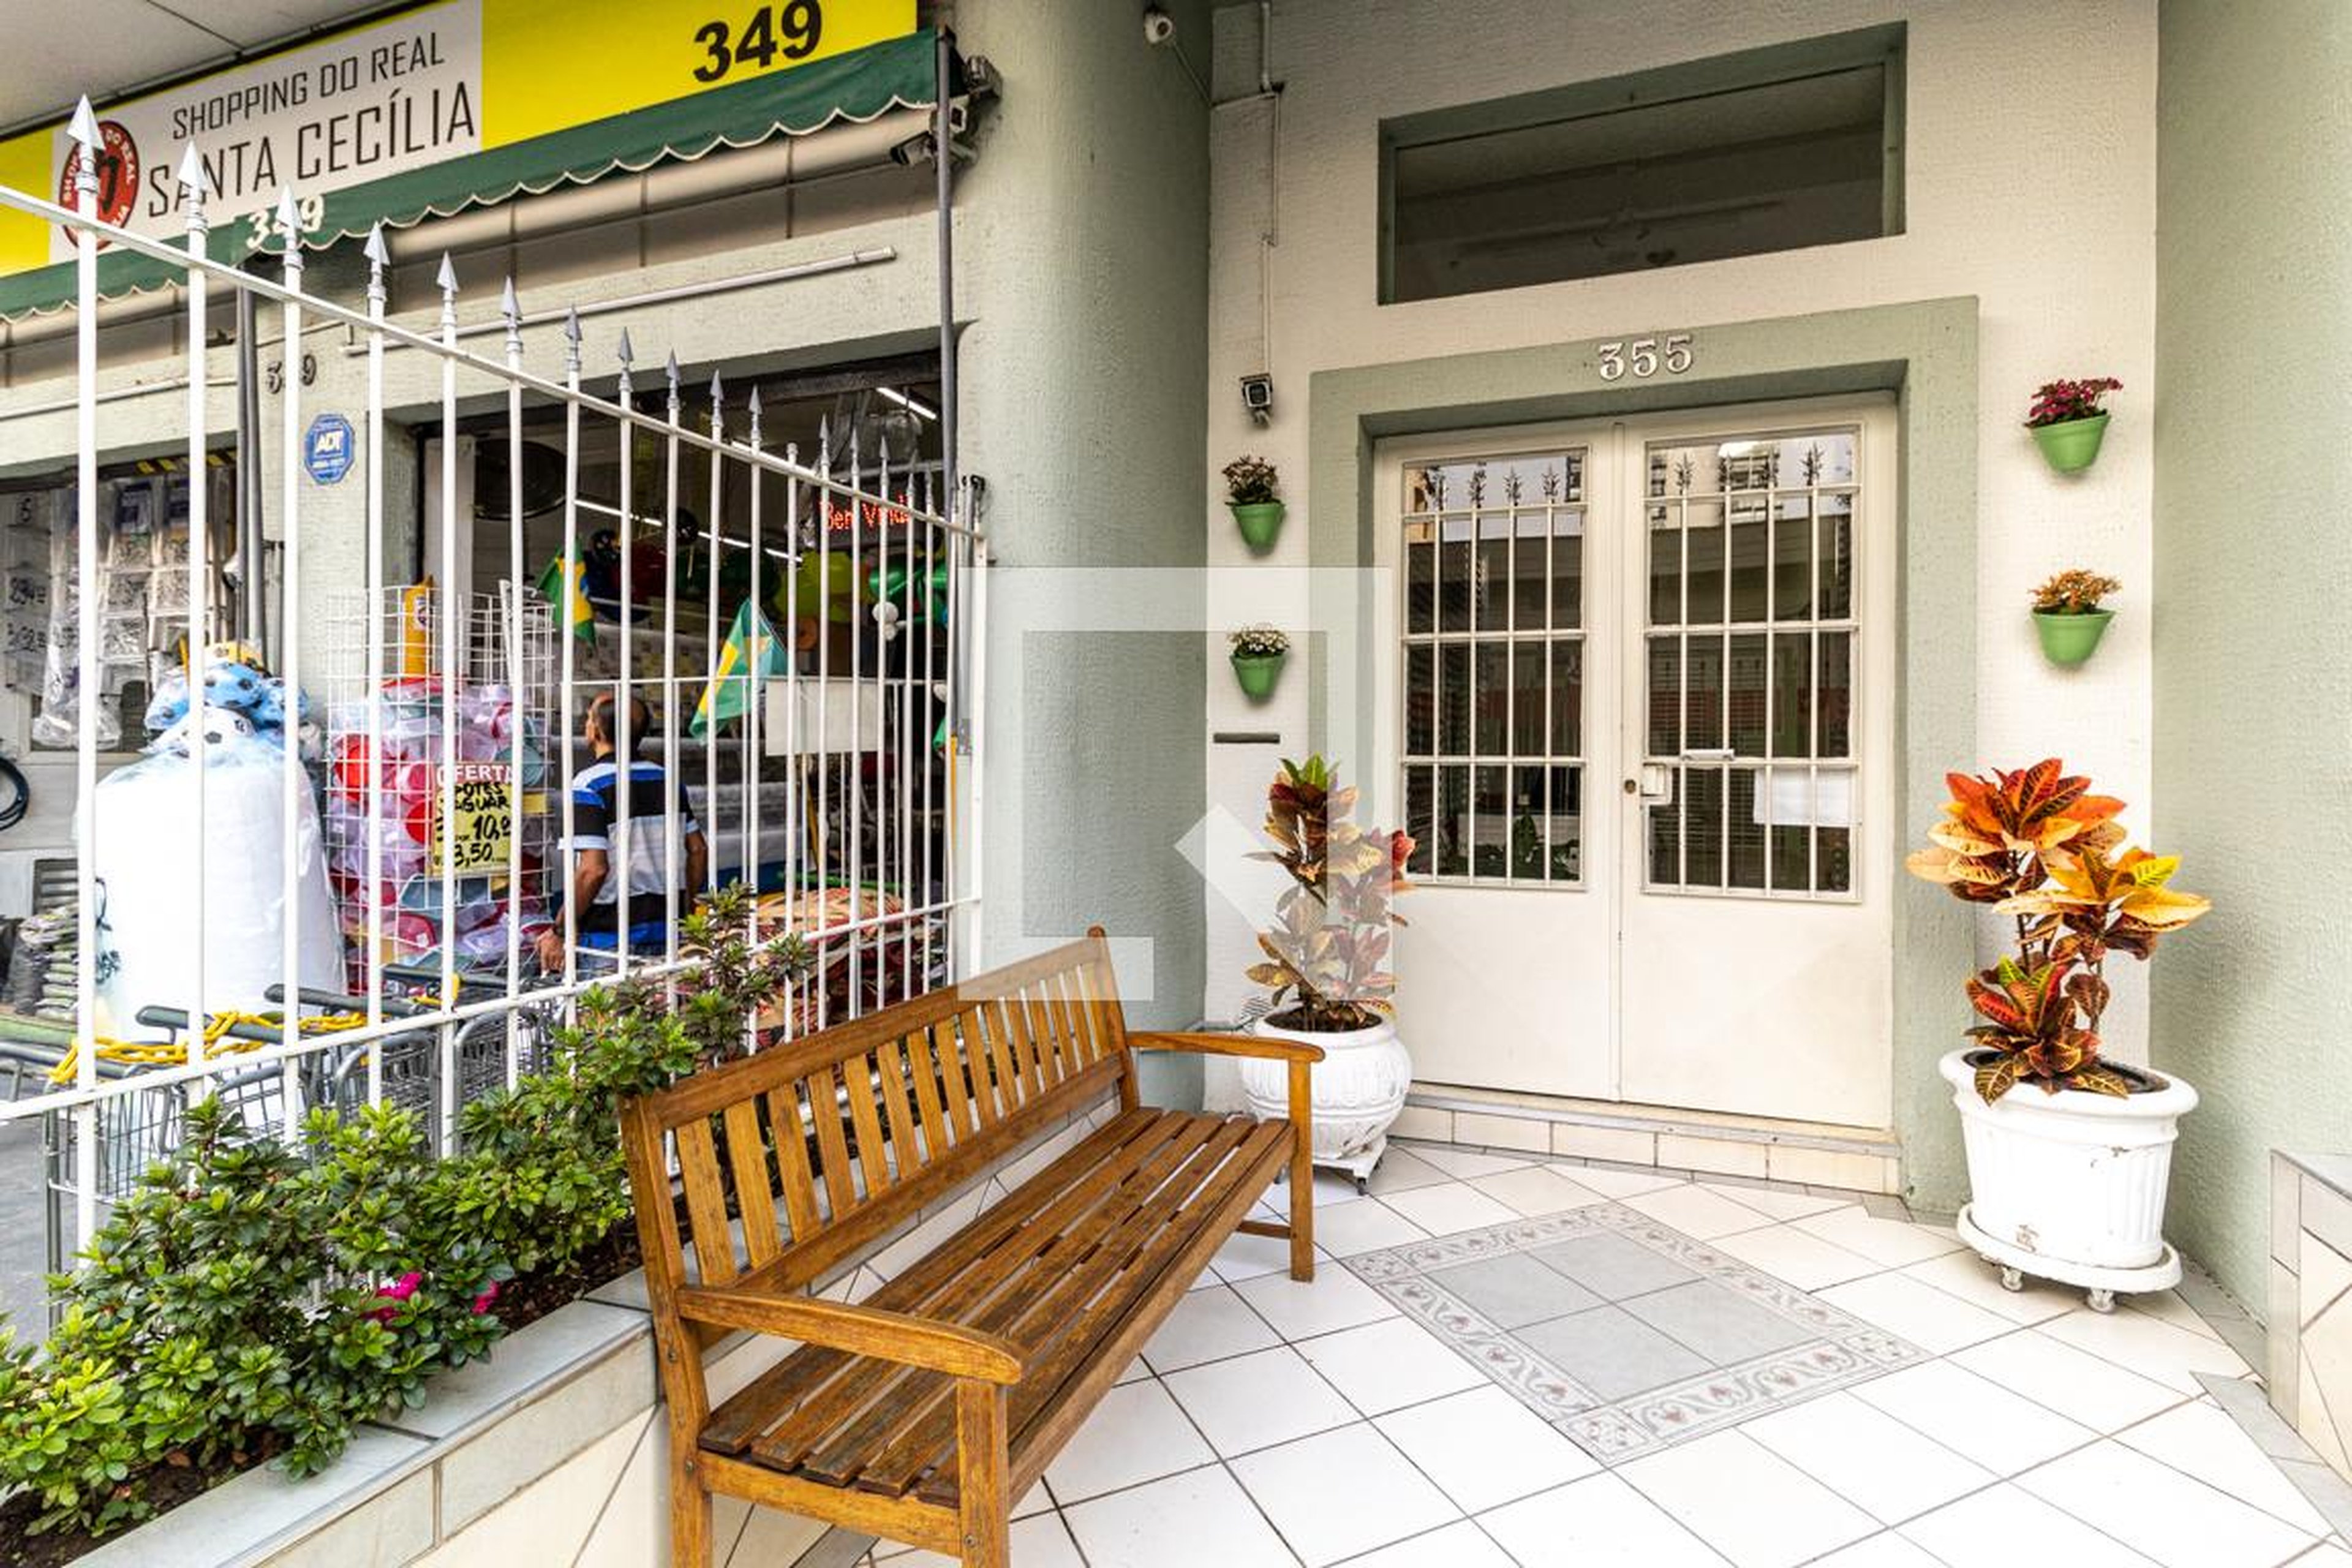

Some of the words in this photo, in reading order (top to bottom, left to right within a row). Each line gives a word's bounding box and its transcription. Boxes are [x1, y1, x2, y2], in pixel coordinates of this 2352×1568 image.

[693, 0, 822, 82] 349
[173, 72, 307, 140] SHOPPING
[320, 56, 358, 98] DO
[371, 32, 445, 83] REAL
[298, 81, 475, 180] CECÍLIA
[246, 195, 324, 249] 39
[266, 354, 317, 394] 39
[1599, 334, 1694, 381] 355
[315, 430, 344, 454] ADT
